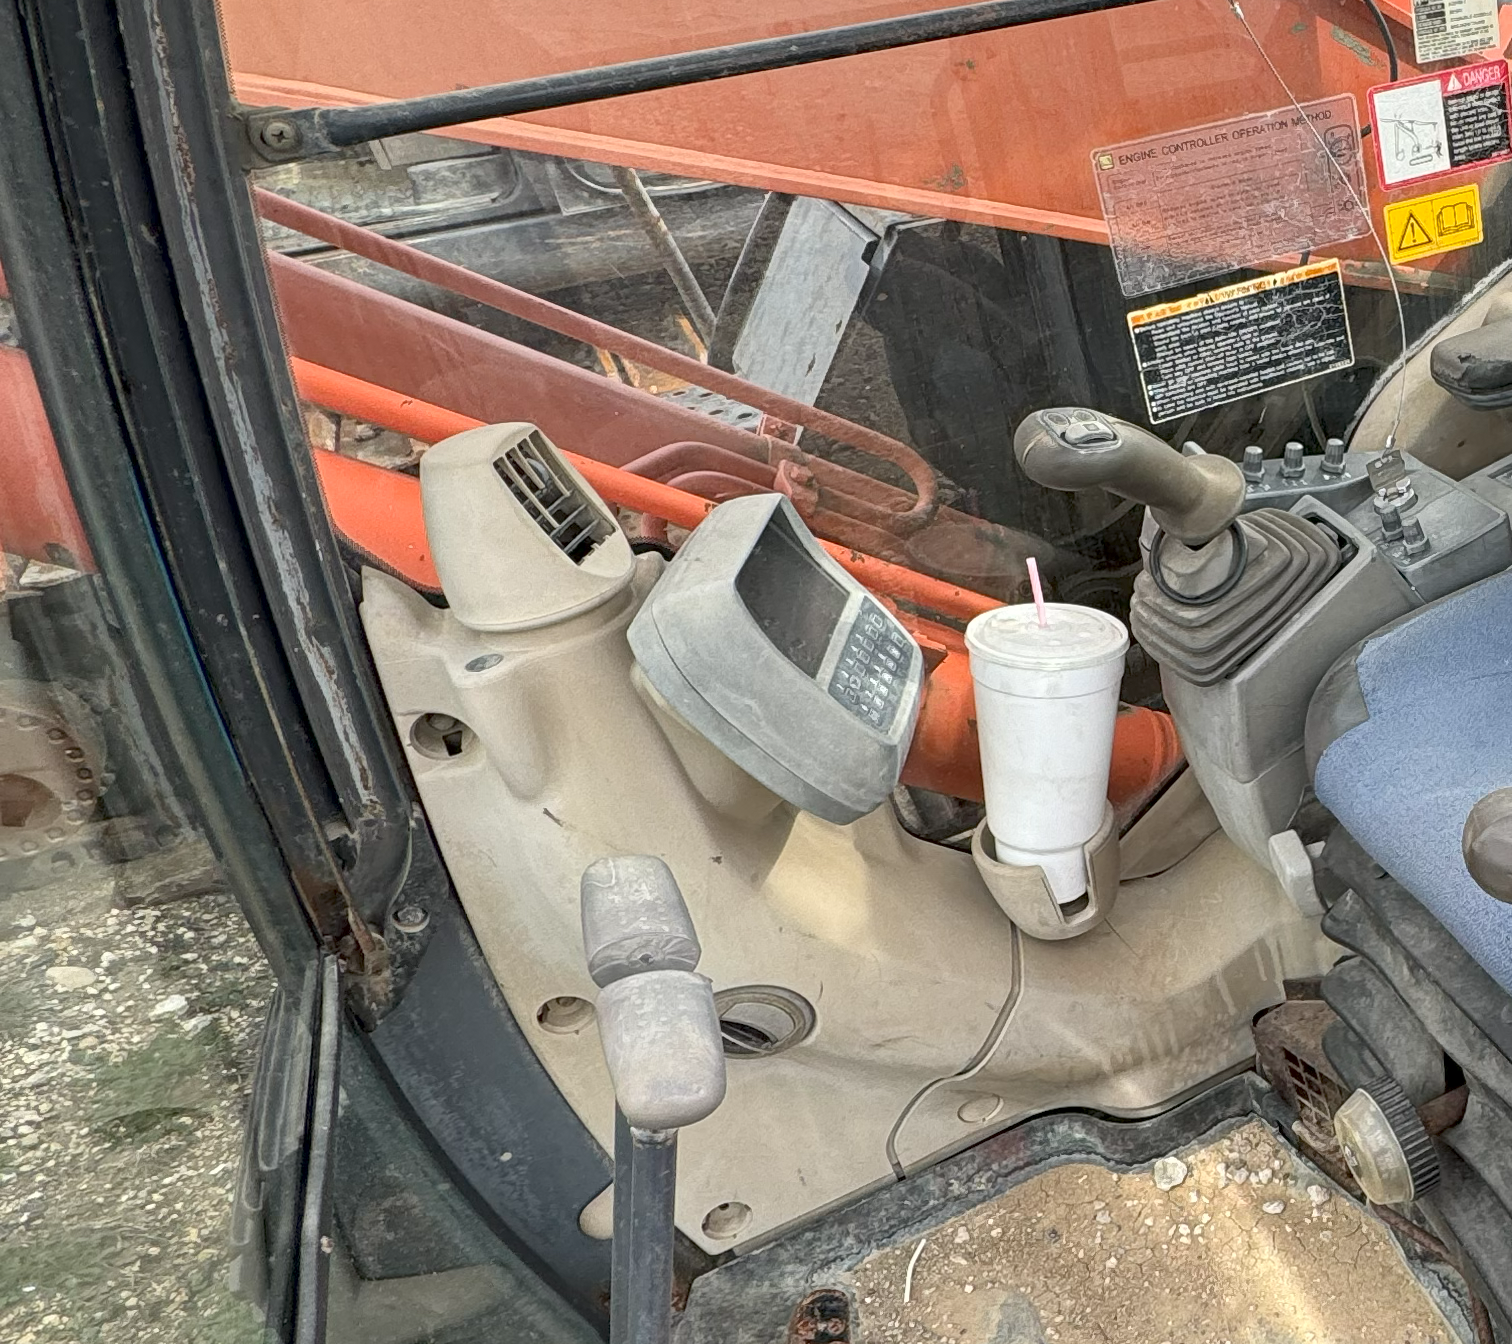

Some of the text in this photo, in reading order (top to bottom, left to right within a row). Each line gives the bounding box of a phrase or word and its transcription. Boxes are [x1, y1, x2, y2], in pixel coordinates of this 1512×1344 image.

[1462, 65, 1501, 86] DANGER
[1119, 148, 1158, 166] ENGINE
[1161, 133, 1229, 156] CONTROLLER
